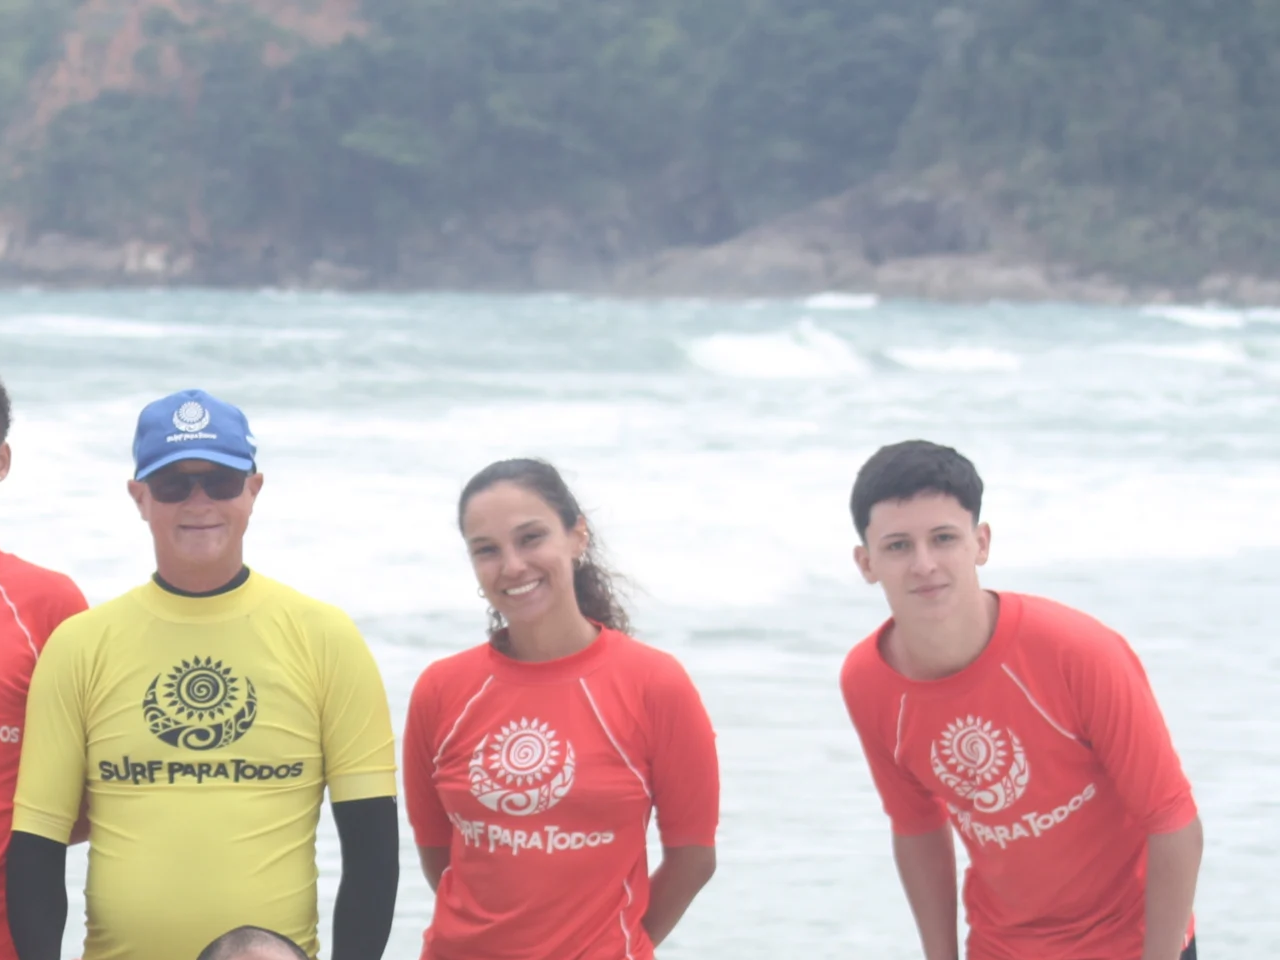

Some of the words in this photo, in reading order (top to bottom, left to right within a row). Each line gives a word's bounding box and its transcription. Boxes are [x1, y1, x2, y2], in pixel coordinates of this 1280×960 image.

[99, 756, 163, 785] SURF
[168, 762, 229, 784] PARA
[231, 759, 303, 783] TODOS
[488, 824, 543, 856] PARA
